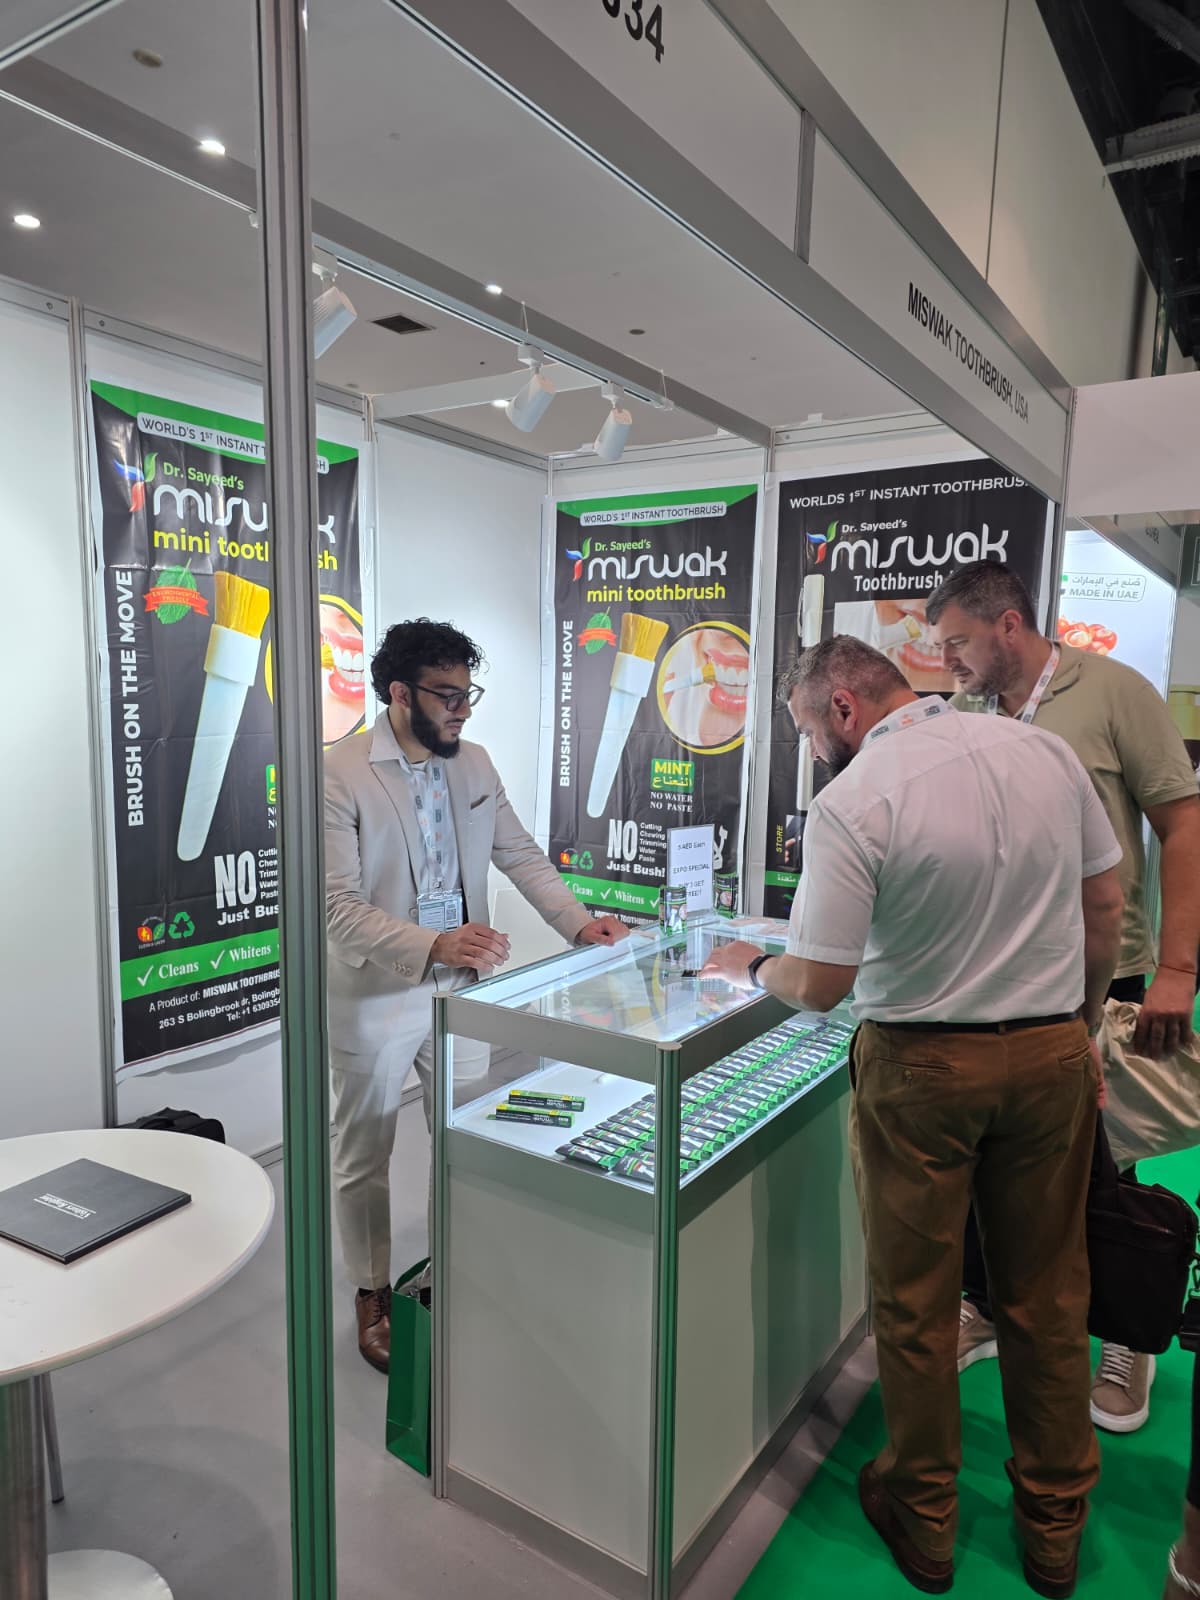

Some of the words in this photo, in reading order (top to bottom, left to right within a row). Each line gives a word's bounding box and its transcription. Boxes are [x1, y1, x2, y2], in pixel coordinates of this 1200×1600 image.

[908, 282, 952, 351] MISWAK
[955, 328, 1013, 412] TOOTHBRUSH,
[1014, 390, 1029, 424] USA
[142, 418, 196, 440] WORLD'S
[216, 434, 259, 454] INSTANT
[163, 462, 184, 478] Dr.
[188, 467, 244, 490] Sayeed's
[790, 492, 845, 509] WORLDS
[850, 489, 866, 503] 1ST
[870, 484, 930, 500] INSTANT
[932, 476, 1029, 494] TOOTHBRUS
[584, 513, 618, 523] WORLD'S
[632, 509, 667, 520] INSTANT
[668, 505, 724, 516] TOOTHBRUSH
[842, 524, 857, 533] Dr.
[860, 520, 908, 533] Sayeed's
[153, 528, 211, 554] mini
[594, 542, 608, 552] Dr.
[610, 538, 652, 552] Sayeed's
[830, 523, 1009, 572] miswak
[588, 545, 728, 581] miswak
[587, 584, 623, 602] mini
[626, 582, 726, 601] toothbrush
[854, 570, 944, 592] Toothbrush
[1069, 588, 1100, 597] MADE
[1102, 590, 1114, 598] IN
[1117, 590, 1139, 599] UAE
[116, 570, 136, 643] MOVE
[562, 620, 574, 667] MOVE
[120, 650, 138, 696] THE
[562, 672, 572, 702] THE
[123, 704, 141, 740] ON
[561, 706, 572, 730] ON
[560, 734, 571, 787] BRUSH
[655, 760, 692, 776] MINT
[125, 746, 144, 827] BRUSH
[650, 792, 663, 800] NO
[664, 792, 692, 803] WATER
[650, 801, 662, 810] NO
[667, 802, 692, 812] PASTE
[607, 818, 638, 861] NO
[776, 824, 784, 854] STORE
[214, 850, 257, 909] NO
[606, 860, 630, 872] Just
[634, 864, 666, 878] Bush!
[260, 880, 278, 888] Wate
[260, 890, 278, 900] Past
[614, 890, 644, 904] Whitens
[217, 908, 250, 926] Just
[254, 904, 279, 918] Bus
[158, 961, 200, 979] Cleans
[228, 944, 272, 962] Whitens
[149, 1002, 156, 1012] A
[157, 996, 189, 1010] Product
[190, 990, 200, 1002] of:
[202, 980, 239, 998] MISWAK
[240, 969, 280, 988] TOOTHBRUS
[159, 1019, 176, 1030] 263
[178, 1014, 185, 1024] S
[186, 1000, 240, 1022] Bolingbrook
[252, 987, 280, 1002] Bolingb
[226, 1012, 240, 1022] Tel:
